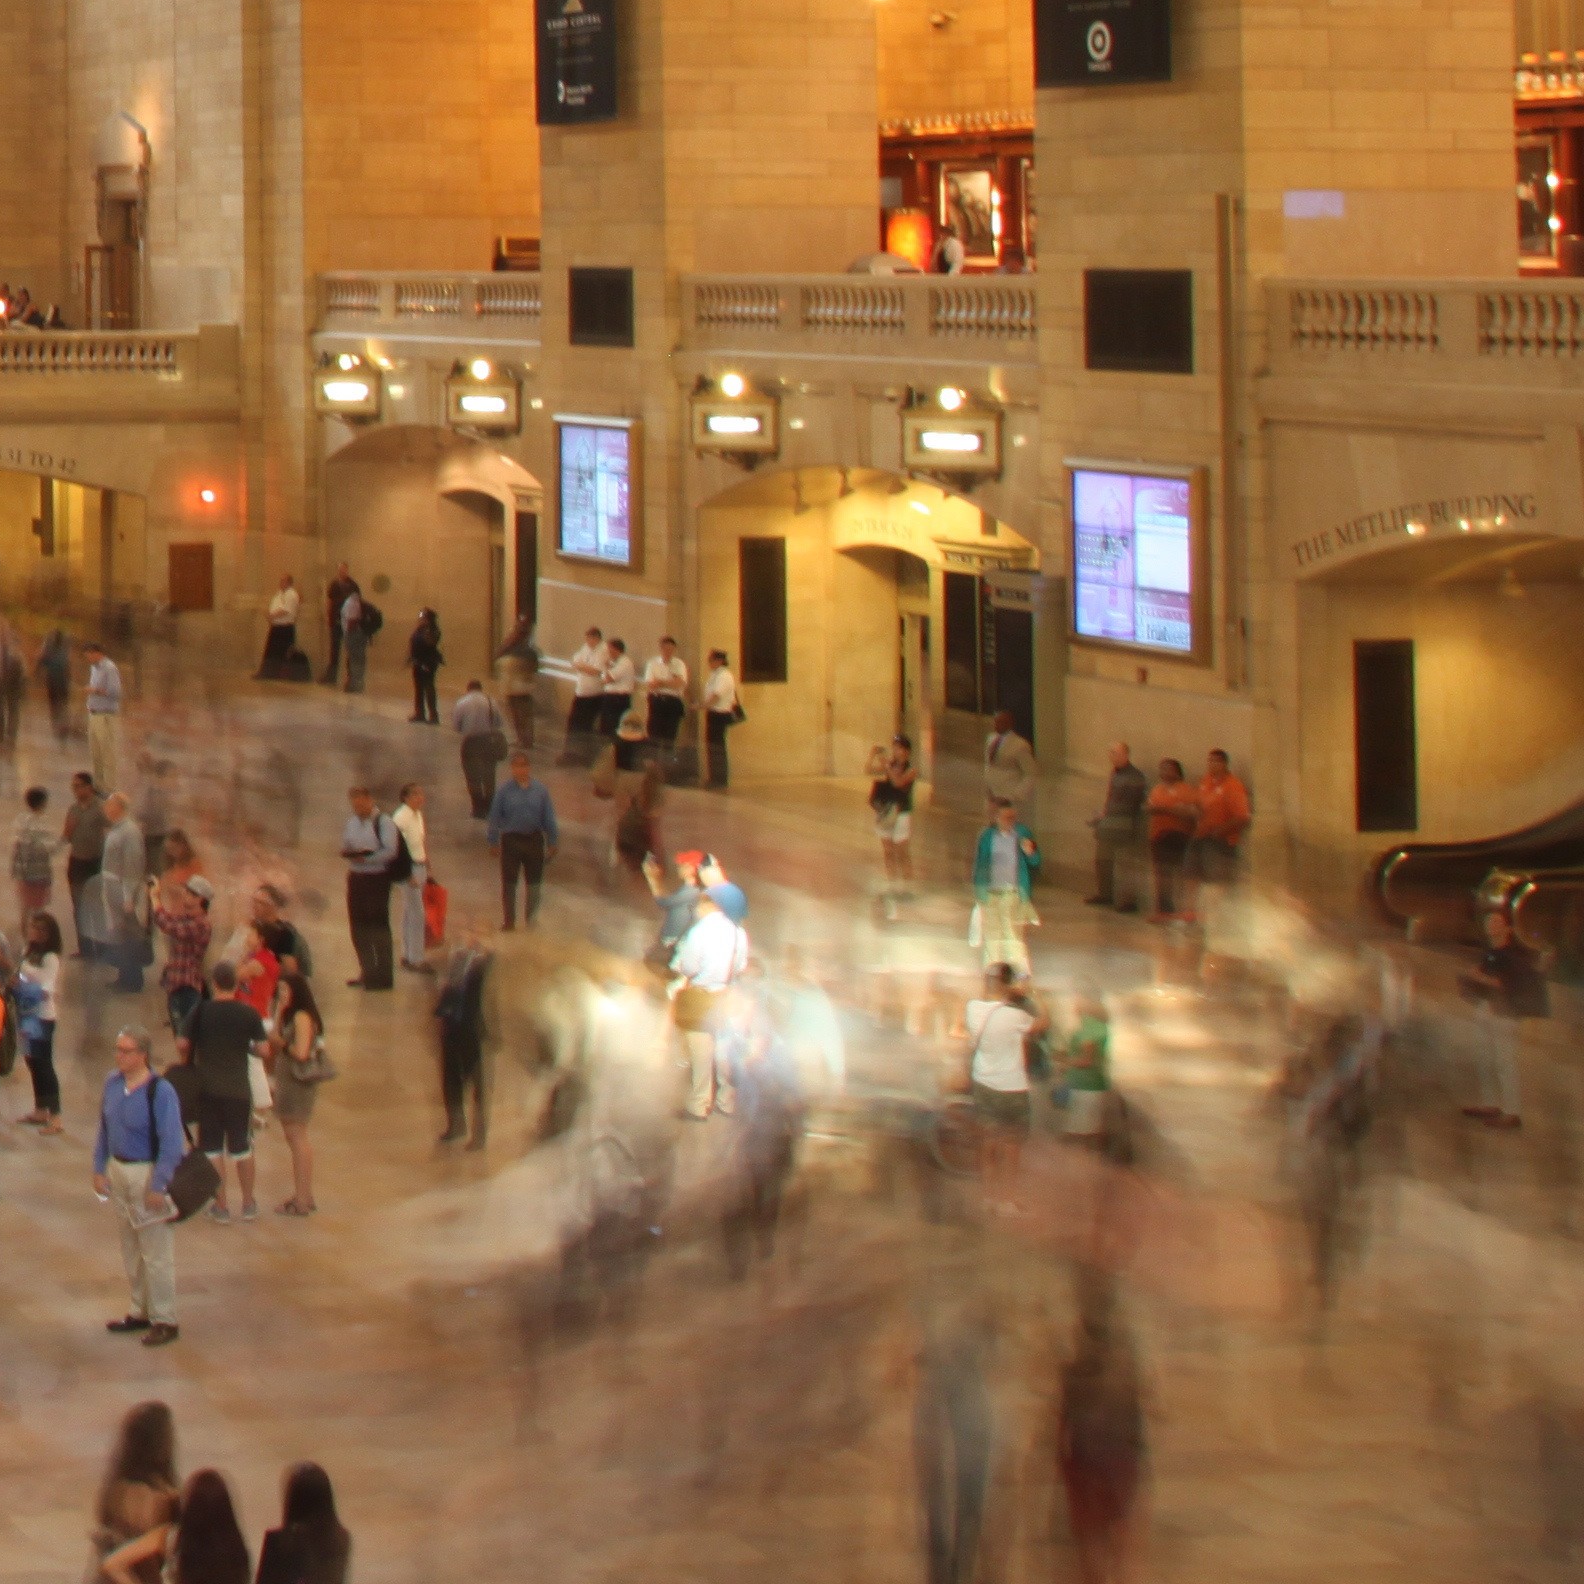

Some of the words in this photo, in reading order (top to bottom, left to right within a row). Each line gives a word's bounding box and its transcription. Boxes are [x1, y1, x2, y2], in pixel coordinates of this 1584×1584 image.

[31, 450, 54, 468] TO
[1291, 531, 1332, 566] THE
[1335, 503, 1424, 550] METLIFE
[1428, 493, 1537, 526] BUILDING
